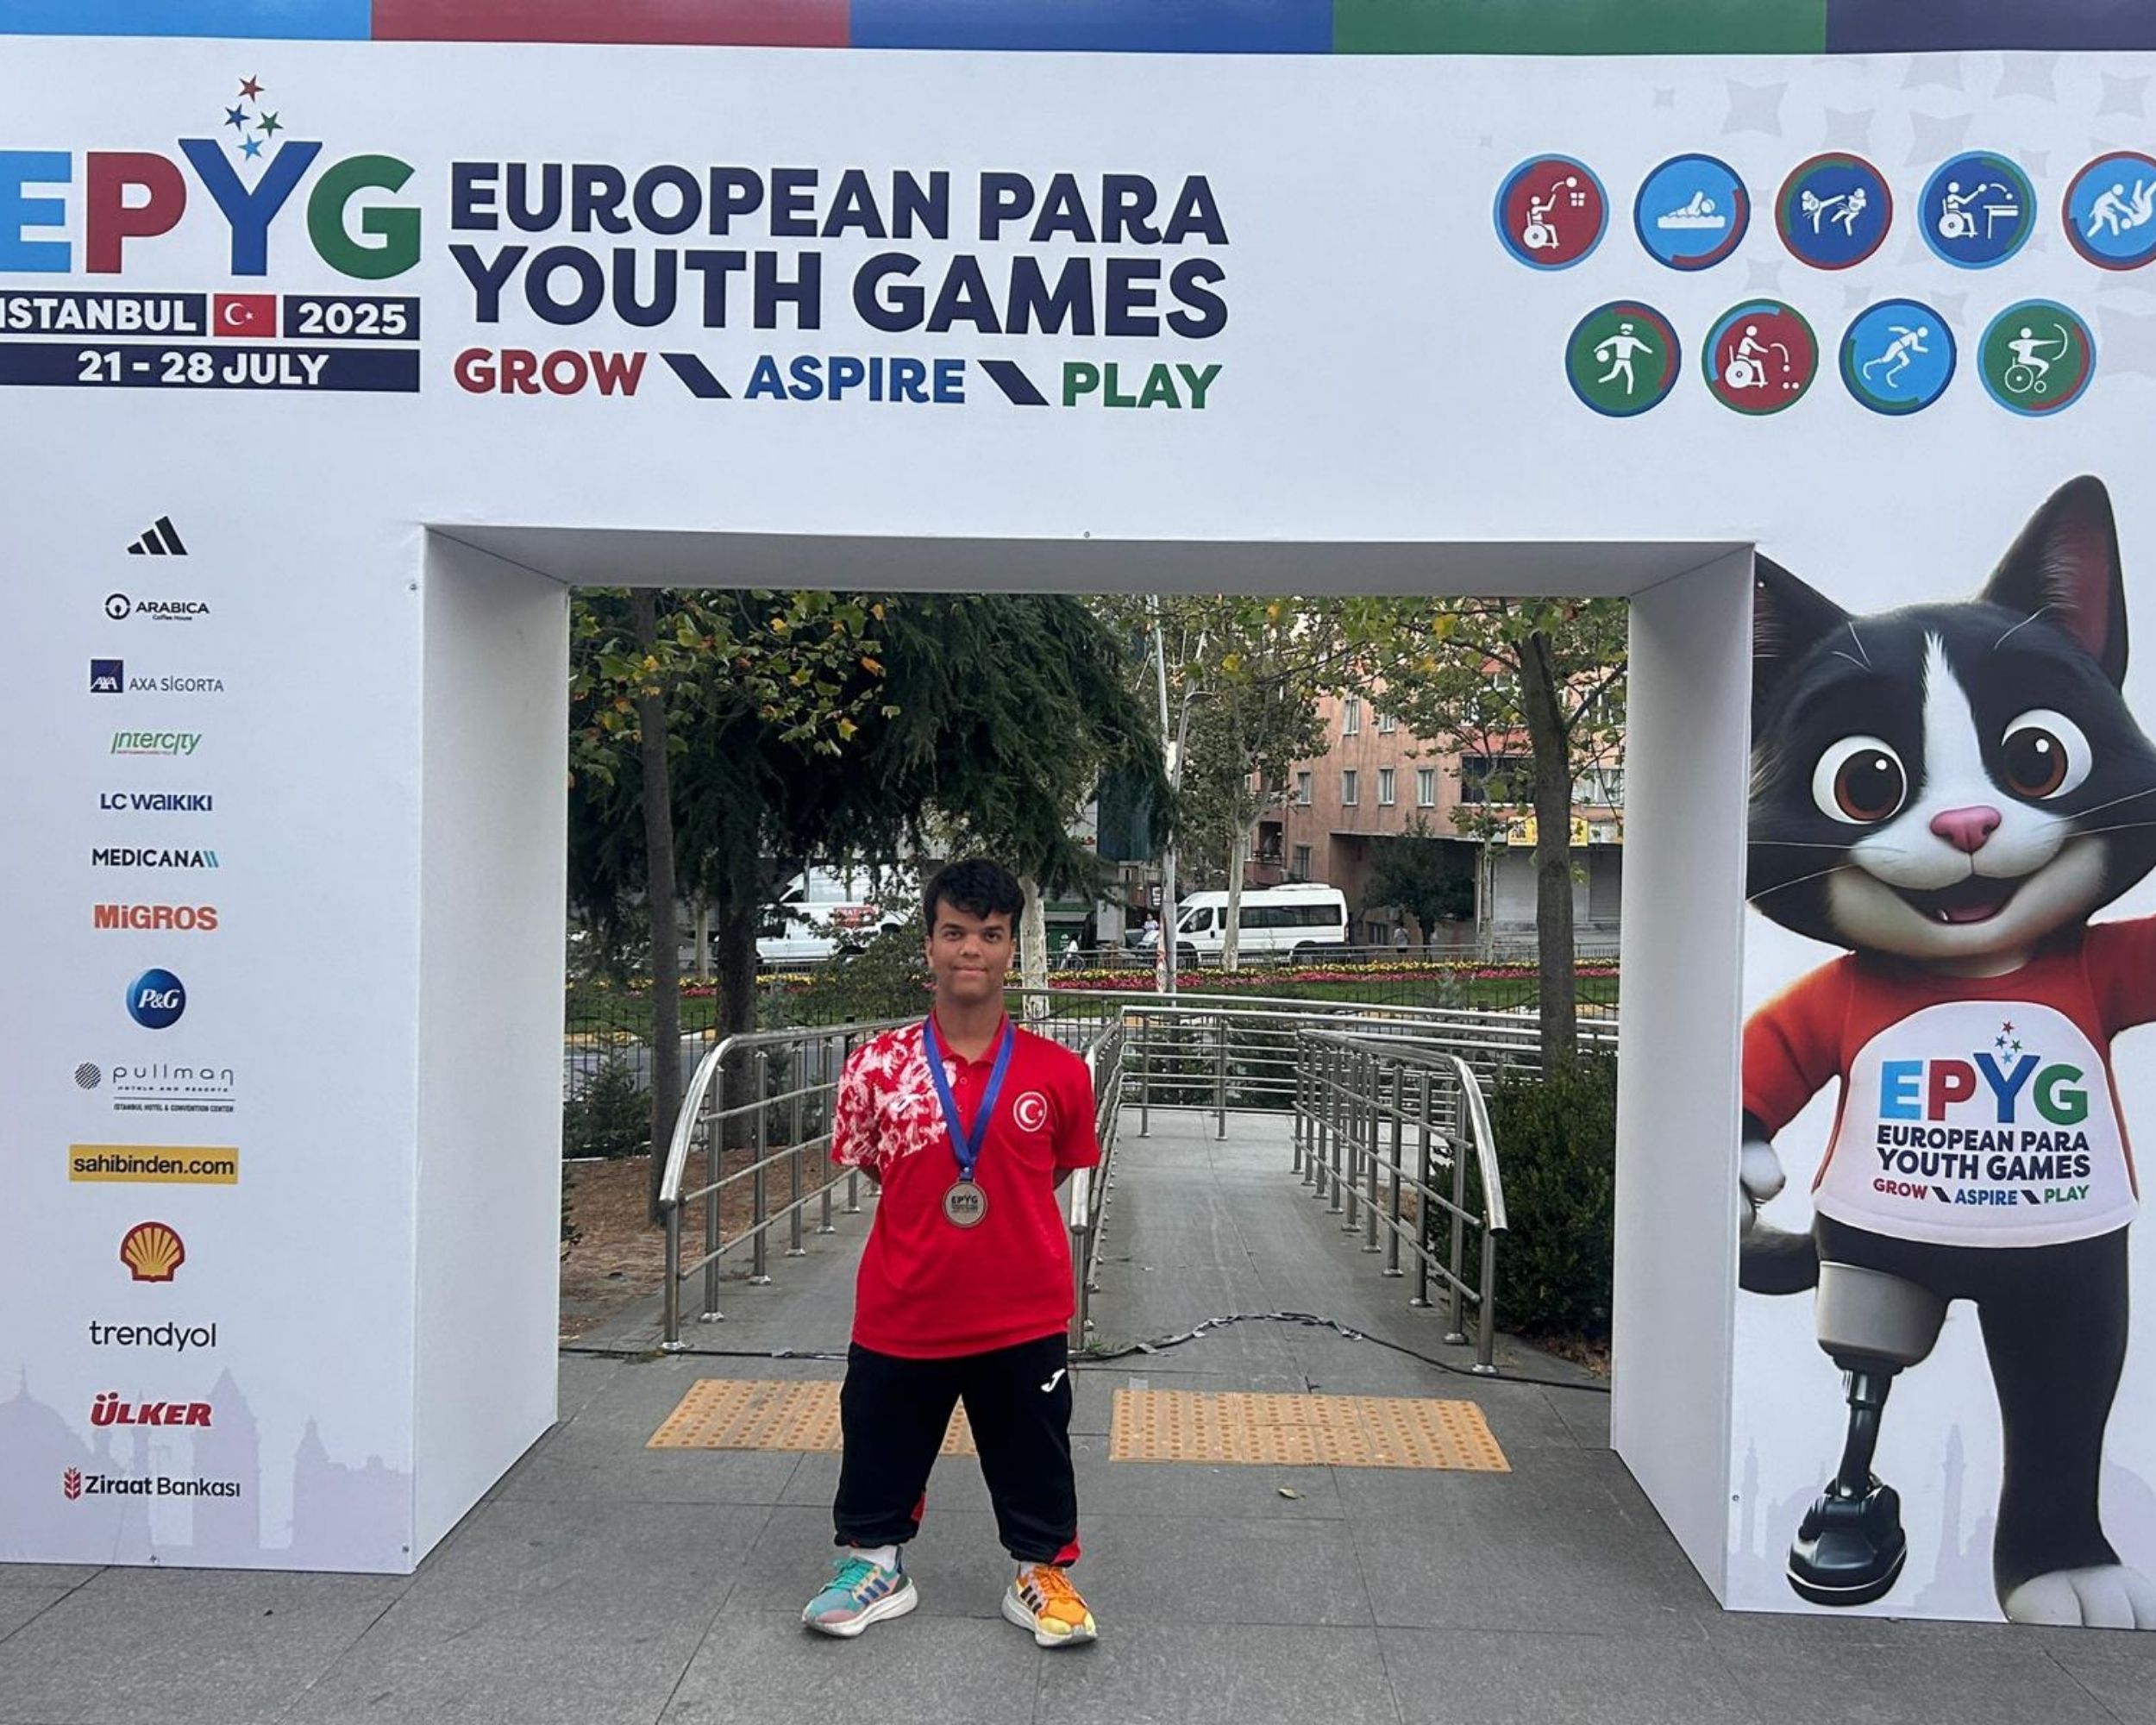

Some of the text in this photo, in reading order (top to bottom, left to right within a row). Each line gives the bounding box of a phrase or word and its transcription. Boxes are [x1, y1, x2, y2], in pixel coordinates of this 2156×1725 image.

[0, 138, 422, 280] EPYG
[451, 161, 1230, 245] EUROPEAN PARA
[448, 244, 1228, 340] YOUTH GAMES
[298, 302, 407, 336] 2025
[78, 350, 330, 386] 21 - 28 JULY
[454, 348, 1223, 410] GROW ASPIRE PLAY
[136, 601, 210, 614] ARABICA
[91, 676, 117, 690] AXA
[129, 675, 224, 693] AXA SİGORTA
[100, 793, 126, 811] LC
[92, 848, 204, 868] MEDICANA
[94, 905, 219, 931] MiGROS
[138, 988, 180, 1009] P&G
[113, 1063, 234, 1086] pullman
[1879, 1052, 2089, 1126] EPYG
[1877, 1124, 2090, 1152] EUROPEAN PARA
[73, 1154, 235, 1175] sahibinden.com
[1877, 1148, 2091, 1182] YOUTH GAMES
[1872, 1178, 2090, 1206] GROW ASPIRE PLAY
[89, 1320, 216, 1352] trendyol
[91, 1391, 212, 1427] ÜLKER
[85, 1474, 241, 1497] Ziraat Bankası
